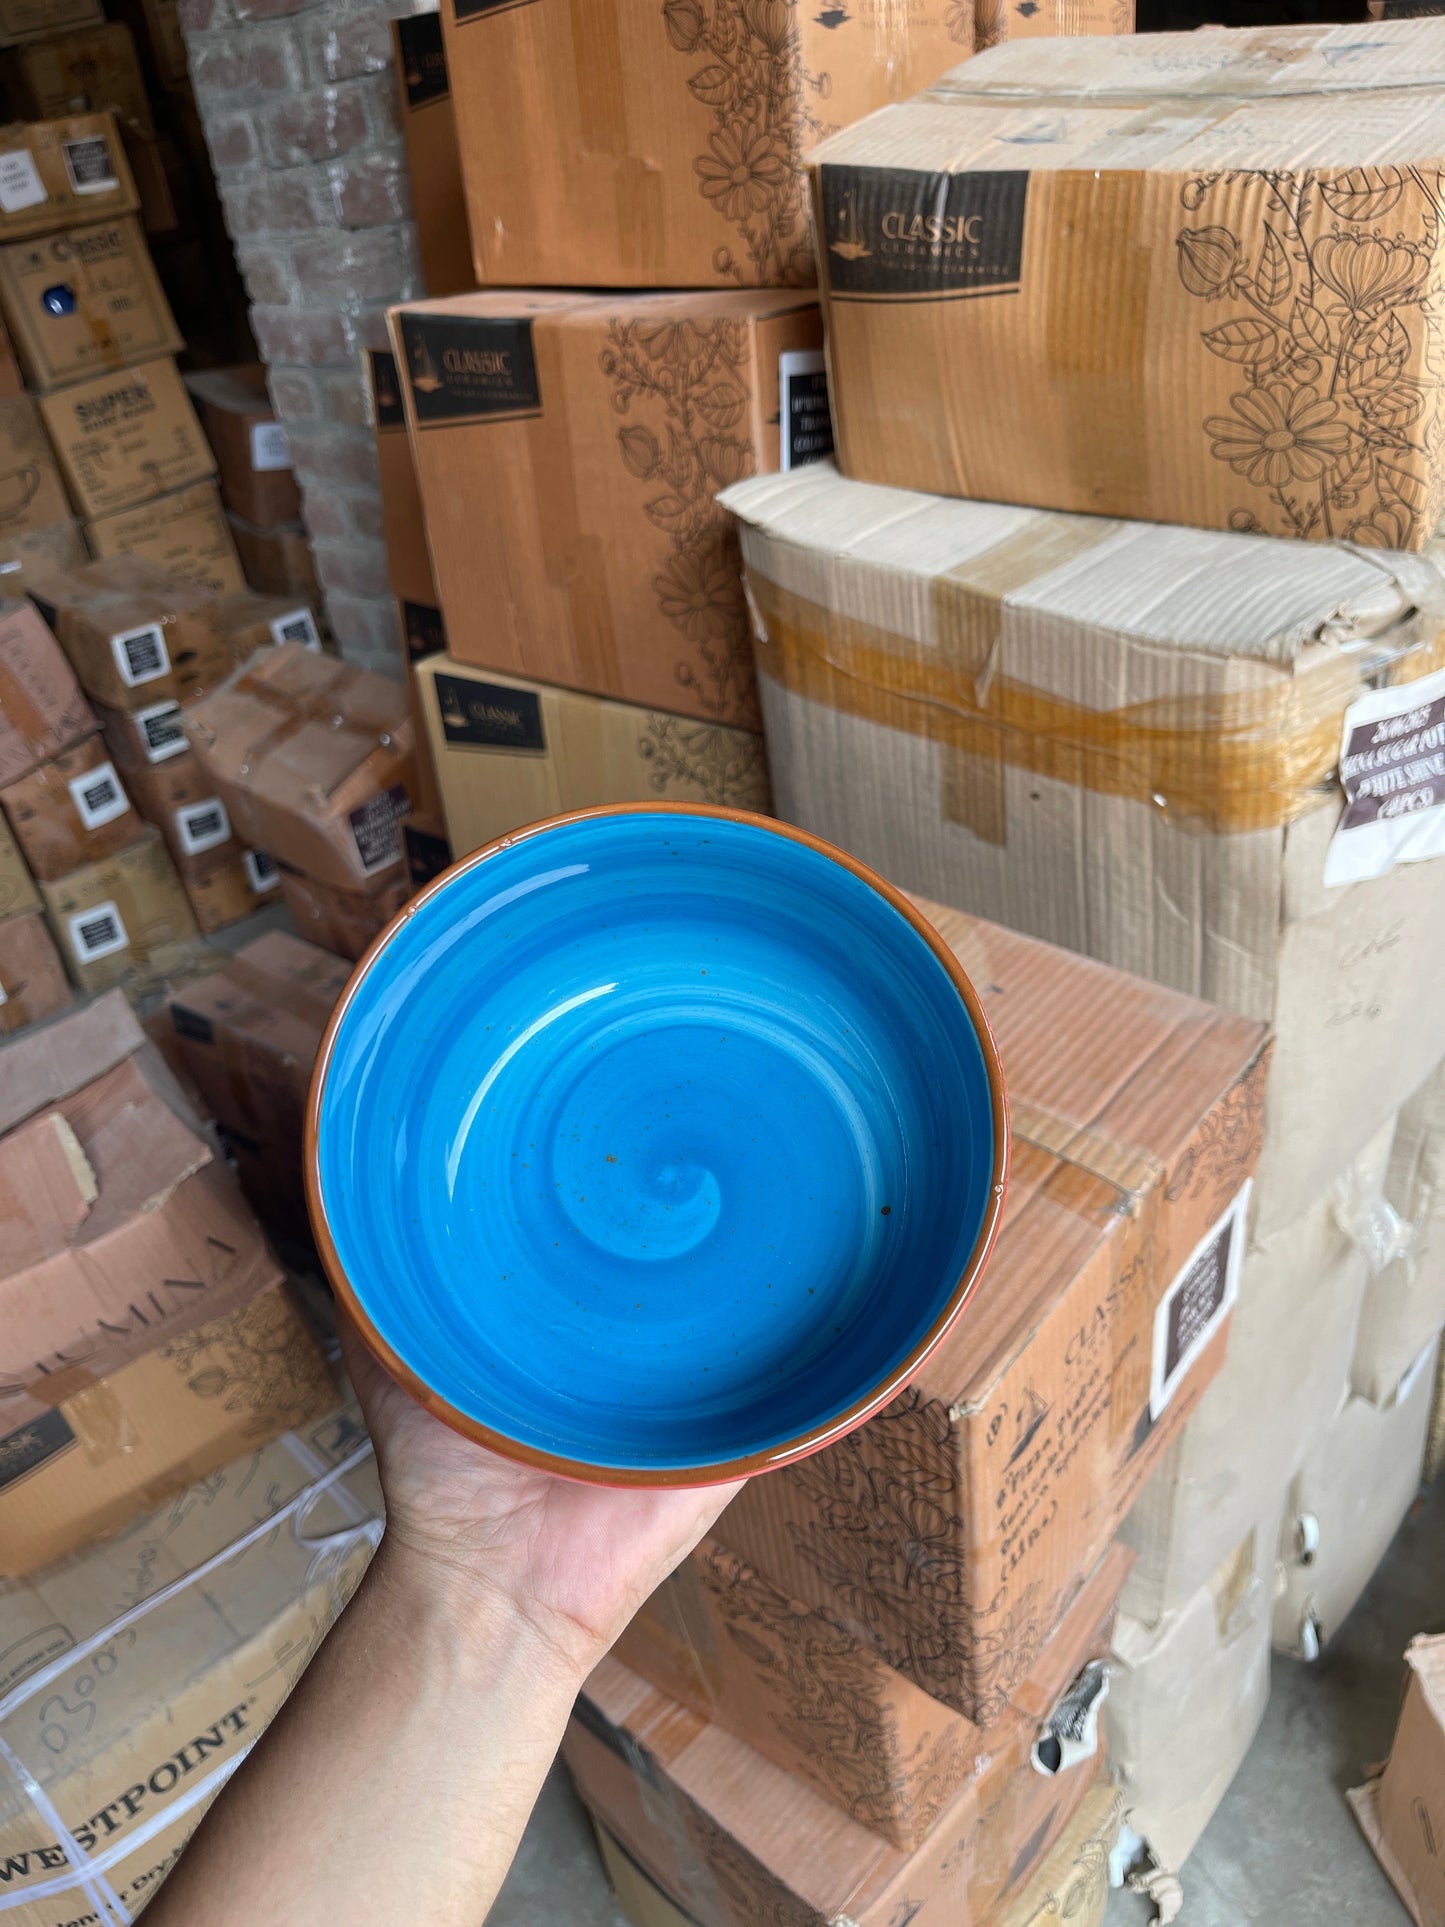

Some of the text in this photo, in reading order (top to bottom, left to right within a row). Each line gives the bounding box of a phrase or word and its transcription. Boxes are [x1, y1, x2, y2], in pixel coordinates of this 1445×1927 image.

[881, 211, 984, 244] CLASSIC
[442, 346, 513, 377] CLASSIC
[0, 1701, 250, 1883] WESTPOINT
